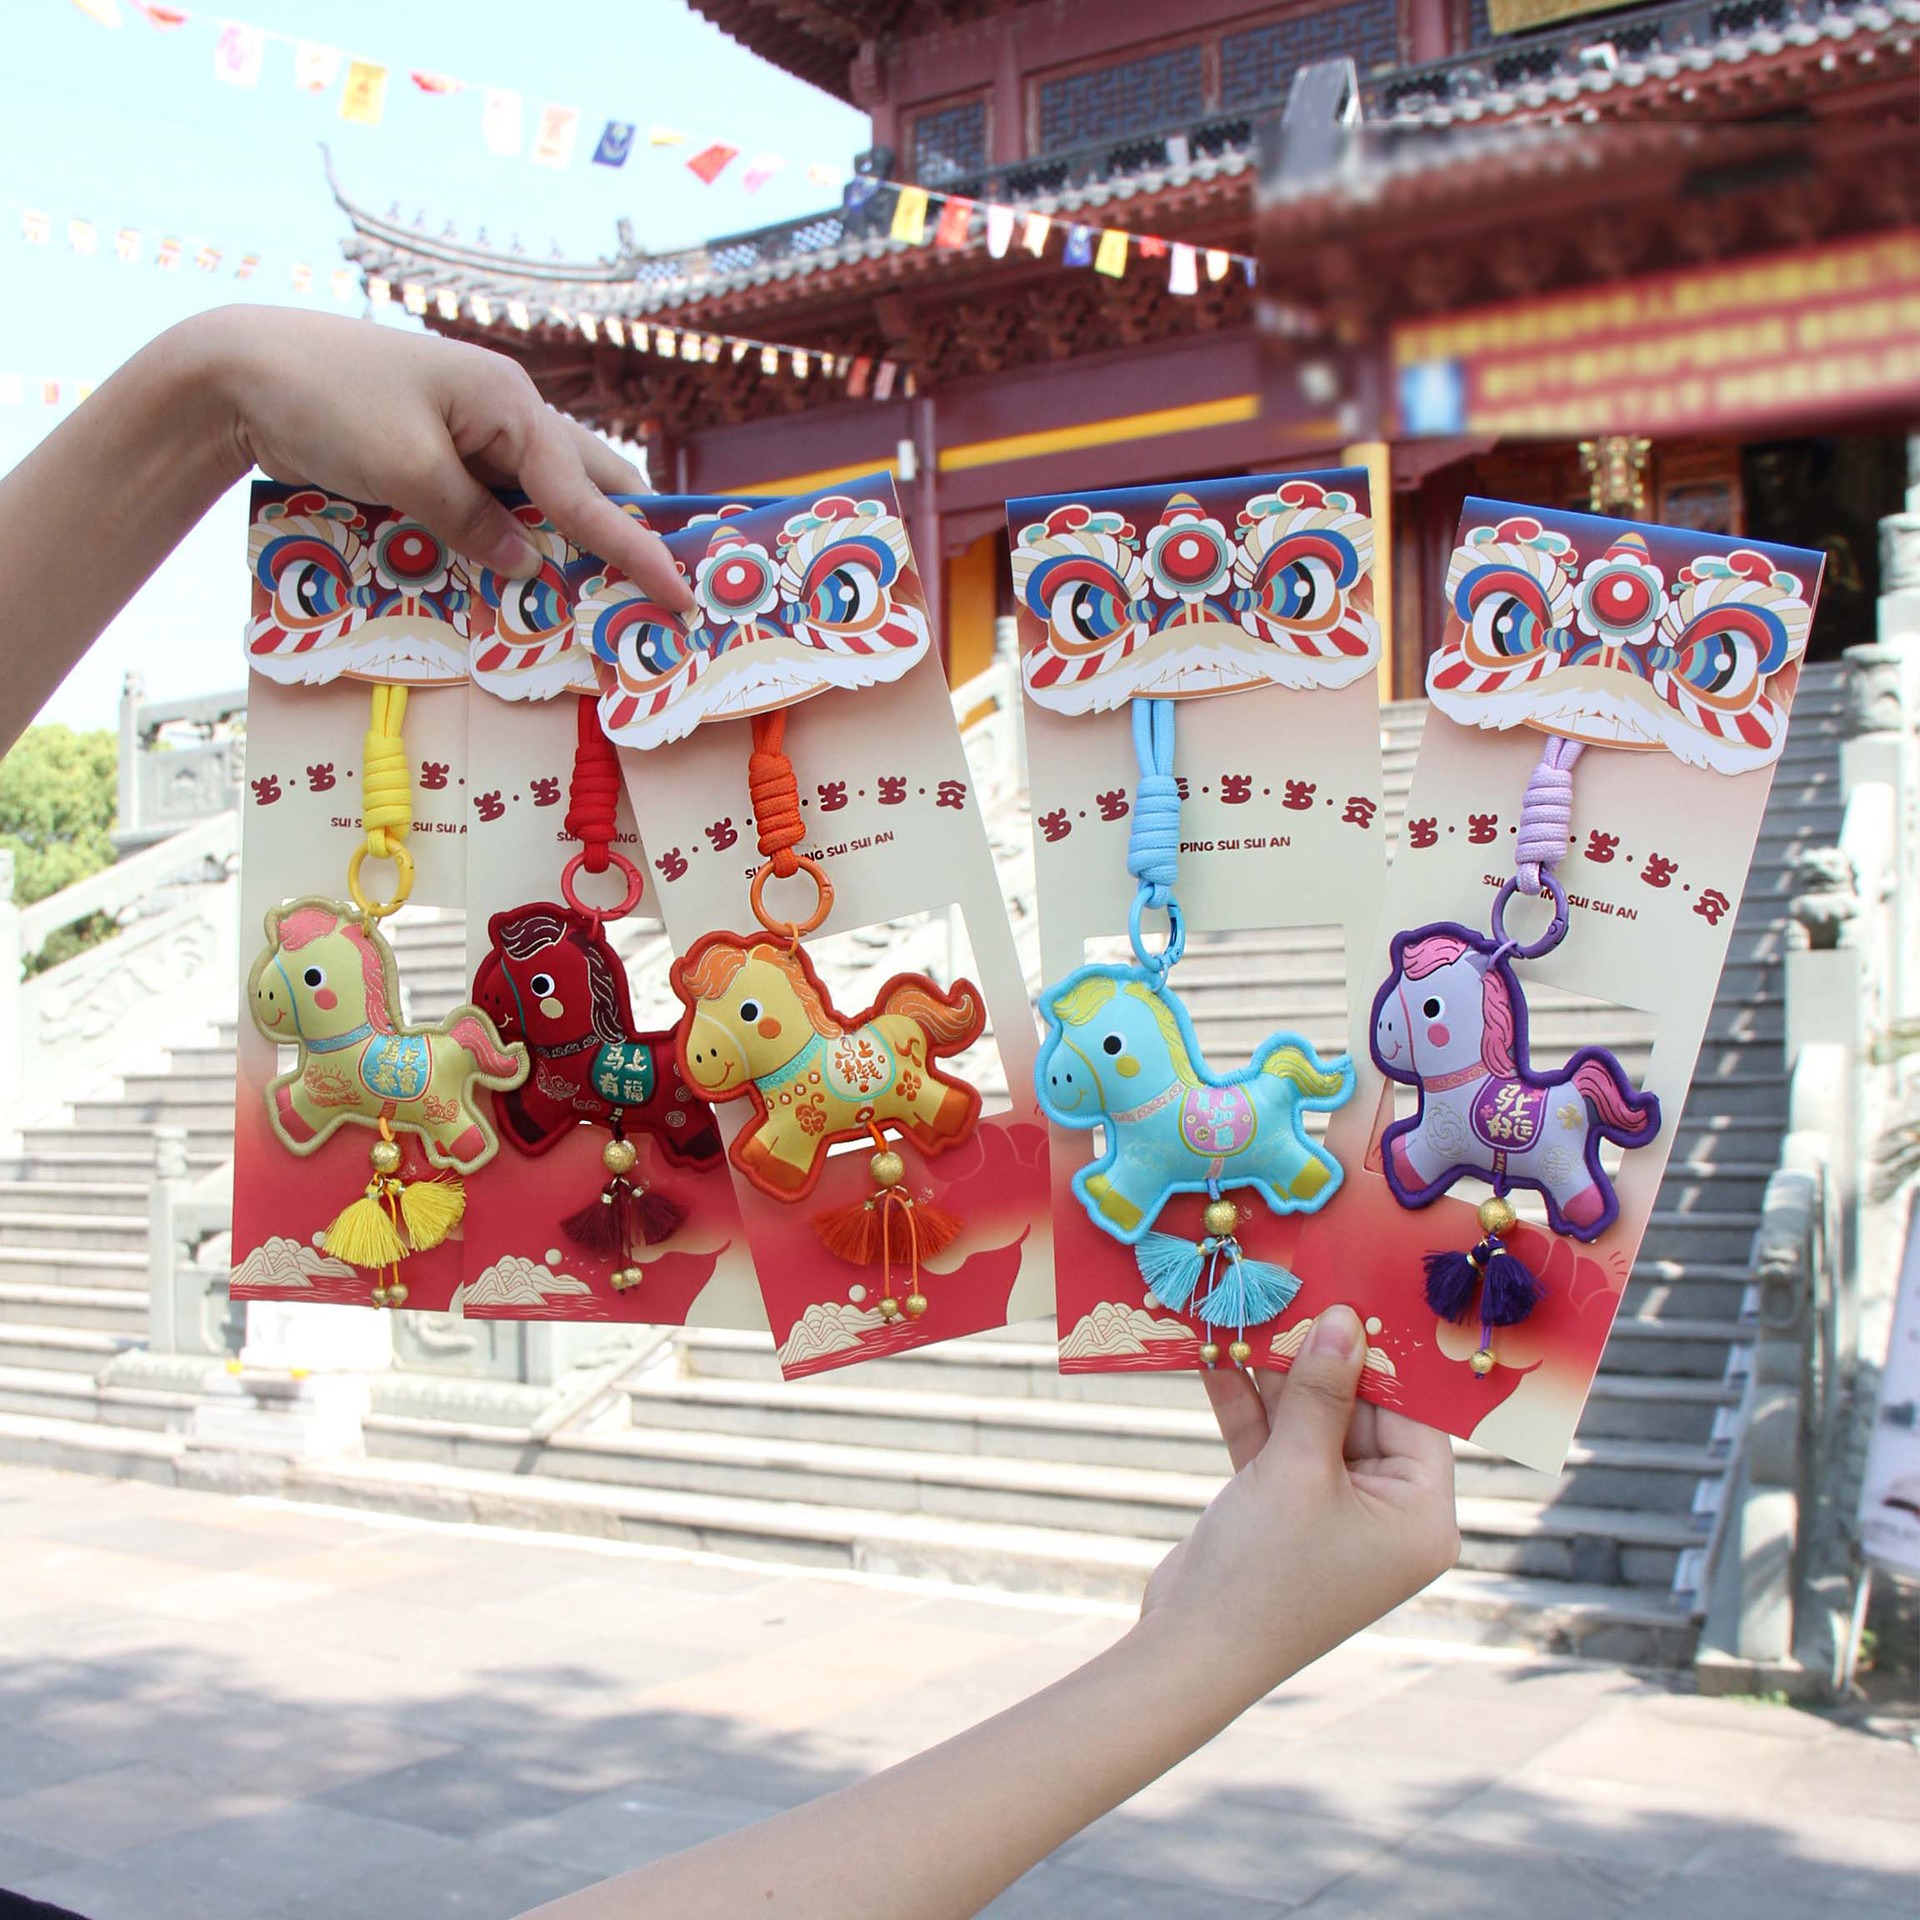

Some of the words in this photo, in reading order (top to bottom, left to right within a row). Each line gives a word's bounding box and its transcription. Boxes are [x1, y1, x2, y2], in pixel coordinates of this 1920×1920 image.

[331, 817, 351, 828] SUI
[412, 822, 433, 832] SUI
[436, 823, 457, 834] SUI
[827, 844, 848, 857] SUI
[850, 837, 872, 851] SUI
[875, 831, 894, 844] AN
[1180, 842, 1214, 853] PING
[1217, 839, 1240, 850] SUI
[1243, 838, 1266, 849] SUI
[1269, 836, 1291, 847] AN
[1567, 894, 1589, 908] SUI
[1591, 900, 1614, 914] SUI
[1616, 908, 1638, 920] AN
[603, 1045, 647, 1071] 马上
[834, 1036, 874, 1060] 马上
[599, 1073, 643, 1102] 有福
[1495, 1083, 1533, 1117] 马上
[1486, 1113, 1534, 1142] 好运
